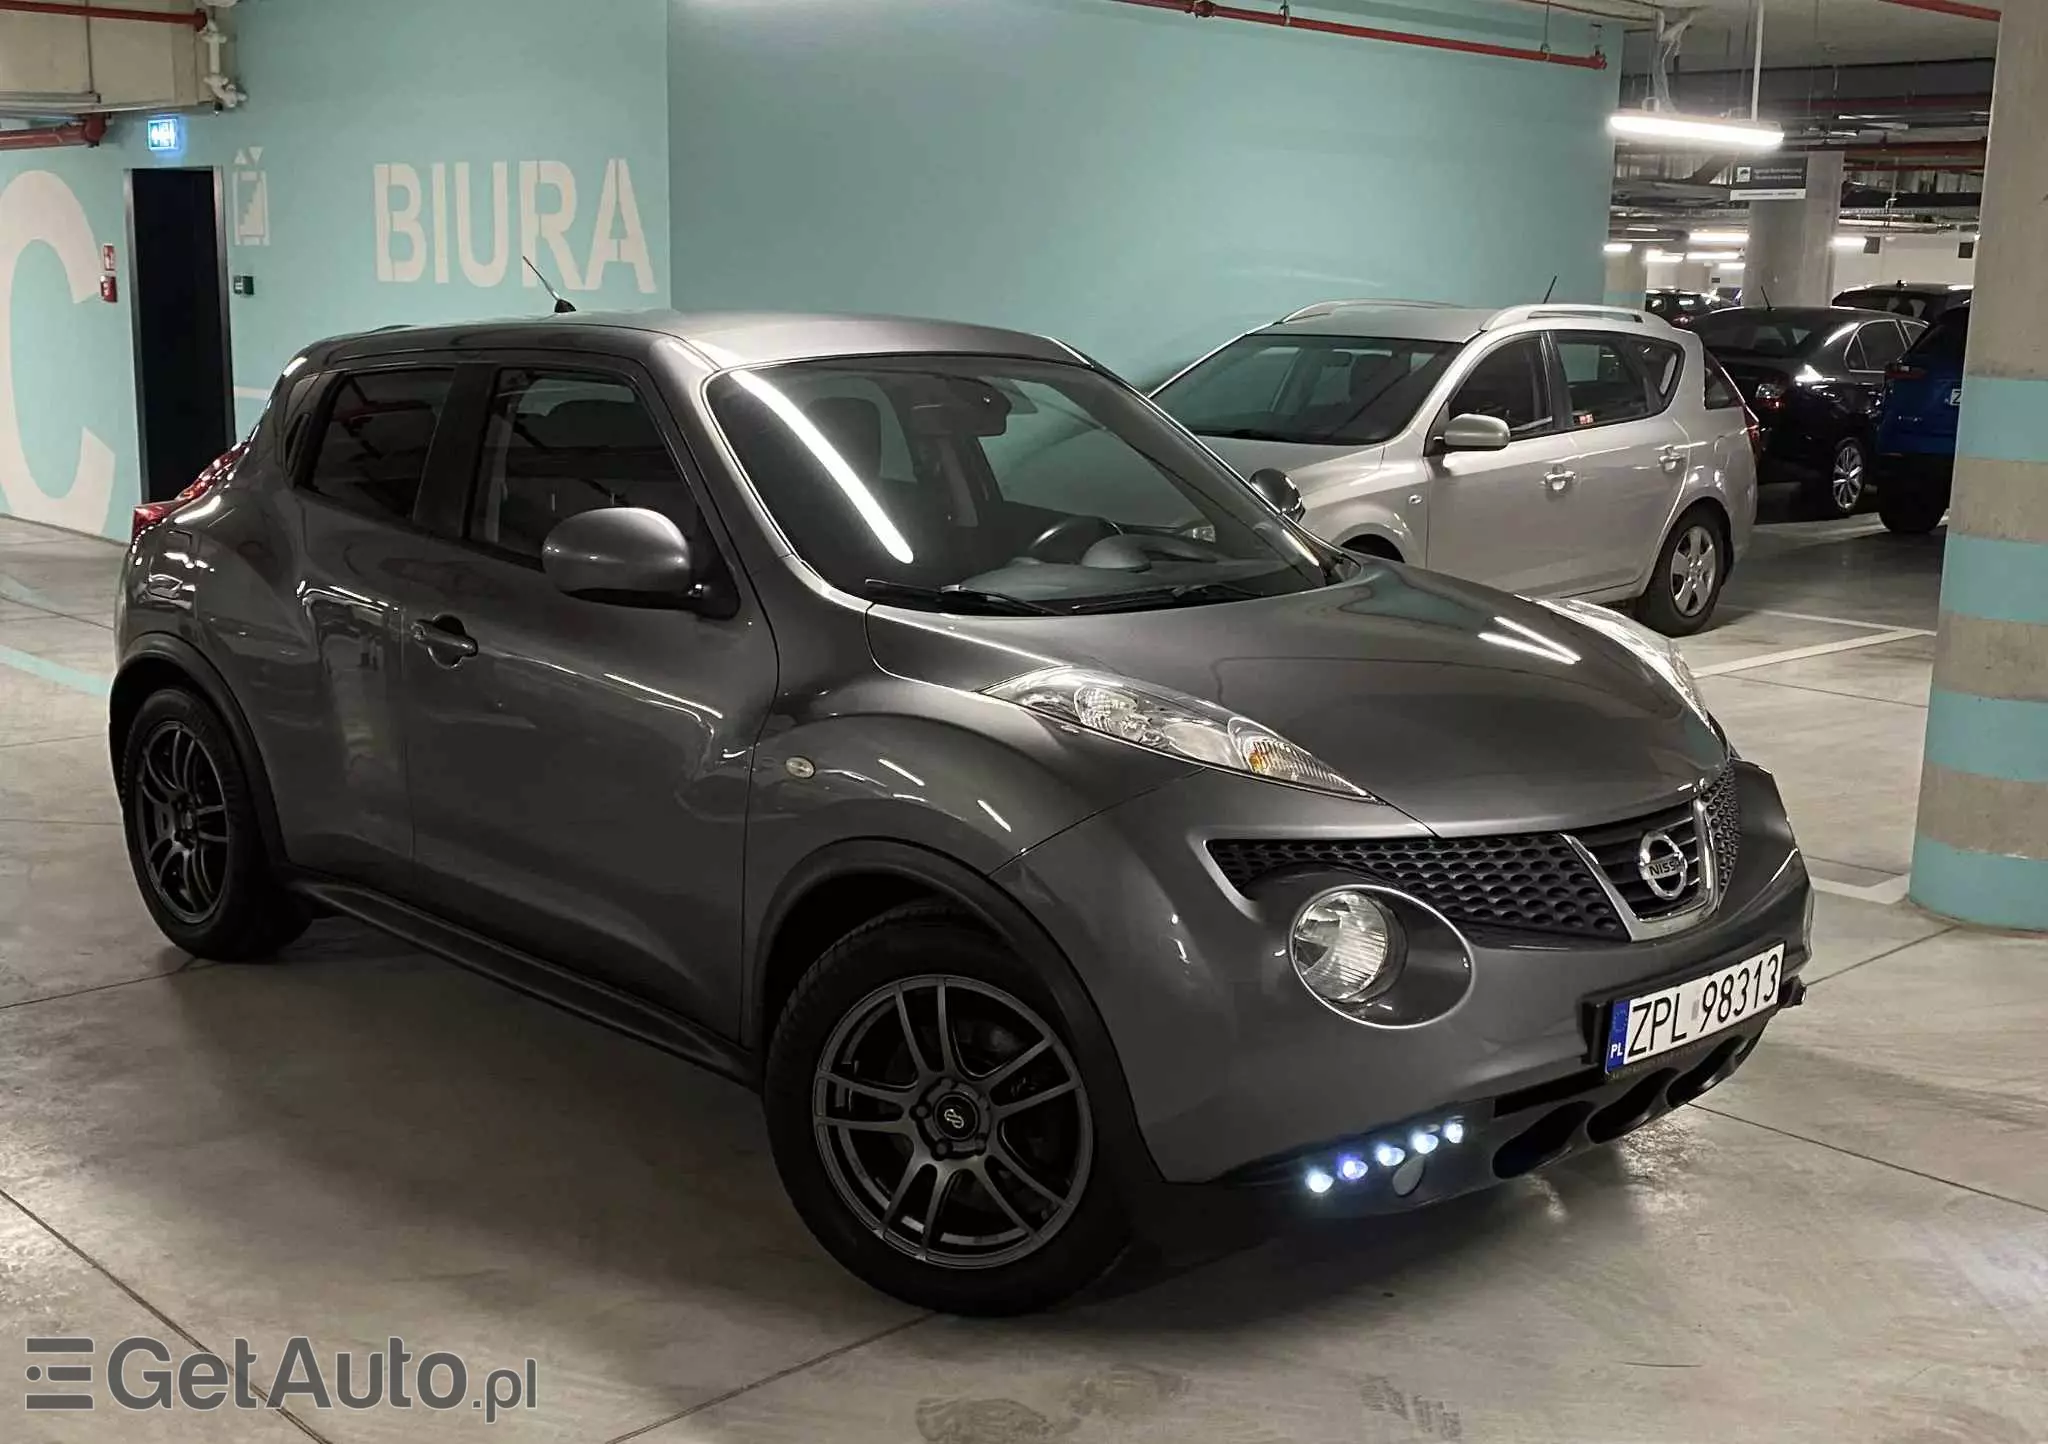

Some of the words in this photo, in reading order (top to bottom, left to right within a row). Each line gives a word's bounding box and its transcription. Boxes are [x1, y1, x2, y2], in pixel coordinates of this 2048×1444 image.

[373, 158, 656, 294] BIURA
[1649, 857, 1683, 876] NISS
[1627, 993, 1687, 1058] ZPL
[1700, 954, 1779, 1033] 98313
[1610, 1042, 1623, 1059] PL
